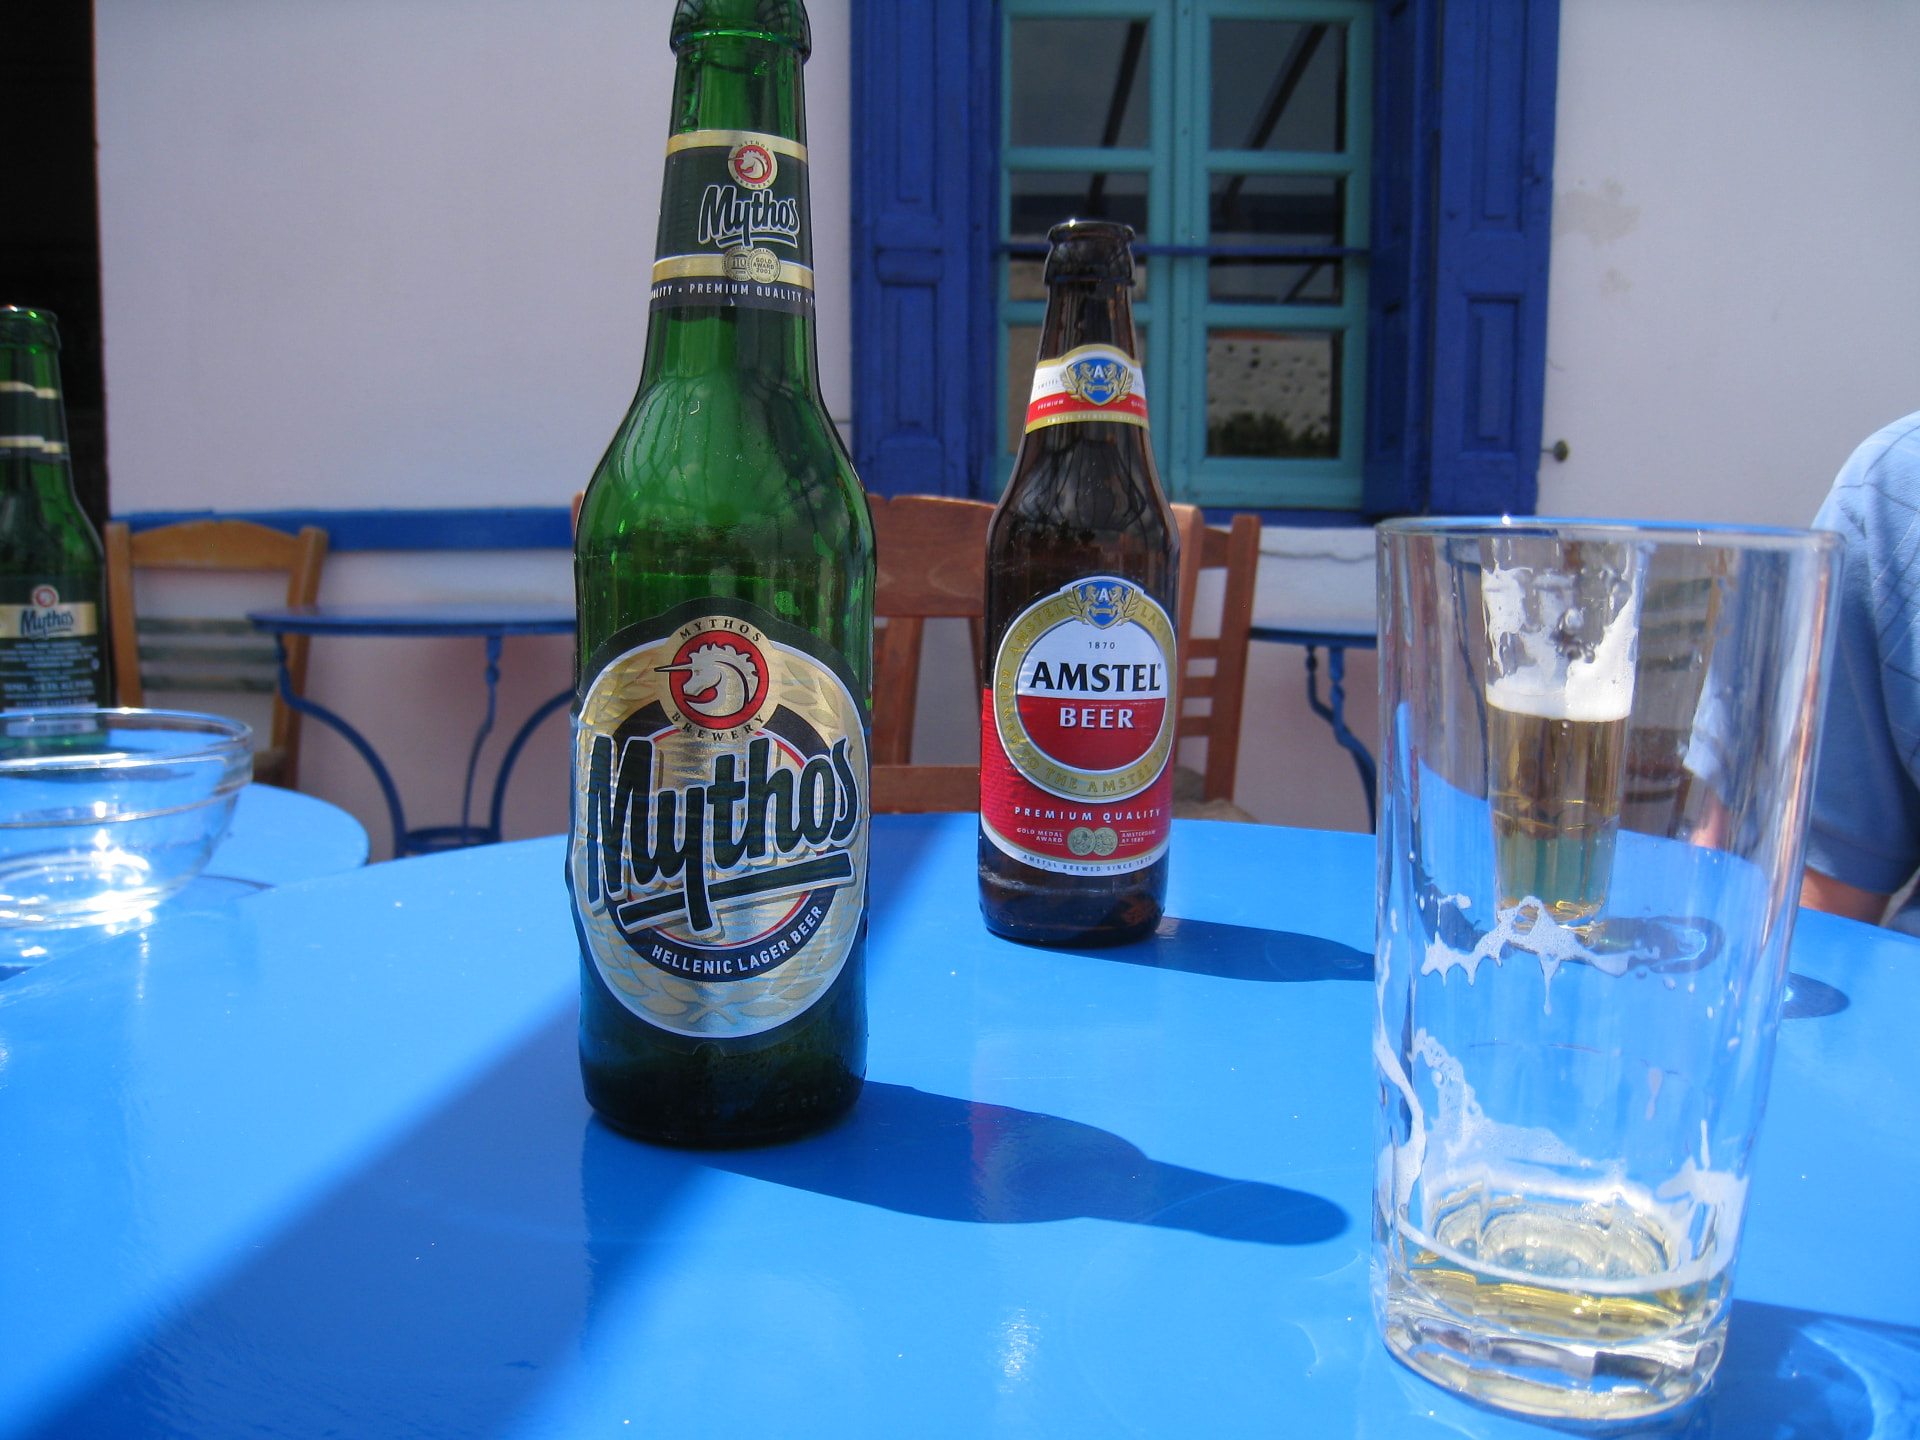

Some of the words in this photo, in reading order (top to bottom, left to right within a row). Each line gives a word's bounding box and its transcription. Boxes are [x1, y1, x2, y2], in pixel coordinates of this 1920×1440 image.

[698, 185, 800, 249] Mythos
[753, 262, 775, 270] AWARD
[689, 283, 749, 295] PREMIUM
[756, 285, 802, 303] QUALITY
[1094, 364, 1104, 378] A
[1098, 587, 1110, 601] A
[20, 609, 74, 638] Mythos
[680, 618, 761, 642] MYTHOS
[1088, 640, 1116, 650] 1870
[1029, 661, 1160, 692] AMSTEL
[671, 711, 765, 742] BREWERY
[1059, 706, 1135, 730] BEER
[1087, 764, 1153, 793] AMSTEL
[1014, 806, 1092, 821] PREMIUM
[1102, 808, 1161, 824] QUALITY
[583, 733, 859, 935] Mythos
[1016, 827, 1035, 835] GOLD
[1037, 830, 1064, 838] MEDAL
[1023, 854, 1057, 868] AMSTEL
[1062, 864, 1101, 872] BREWED
[651, 944, 733, 975] HELLENIC
[737, 939, 791, 973] LAGER
[788, 905, 823, 945] BEER
